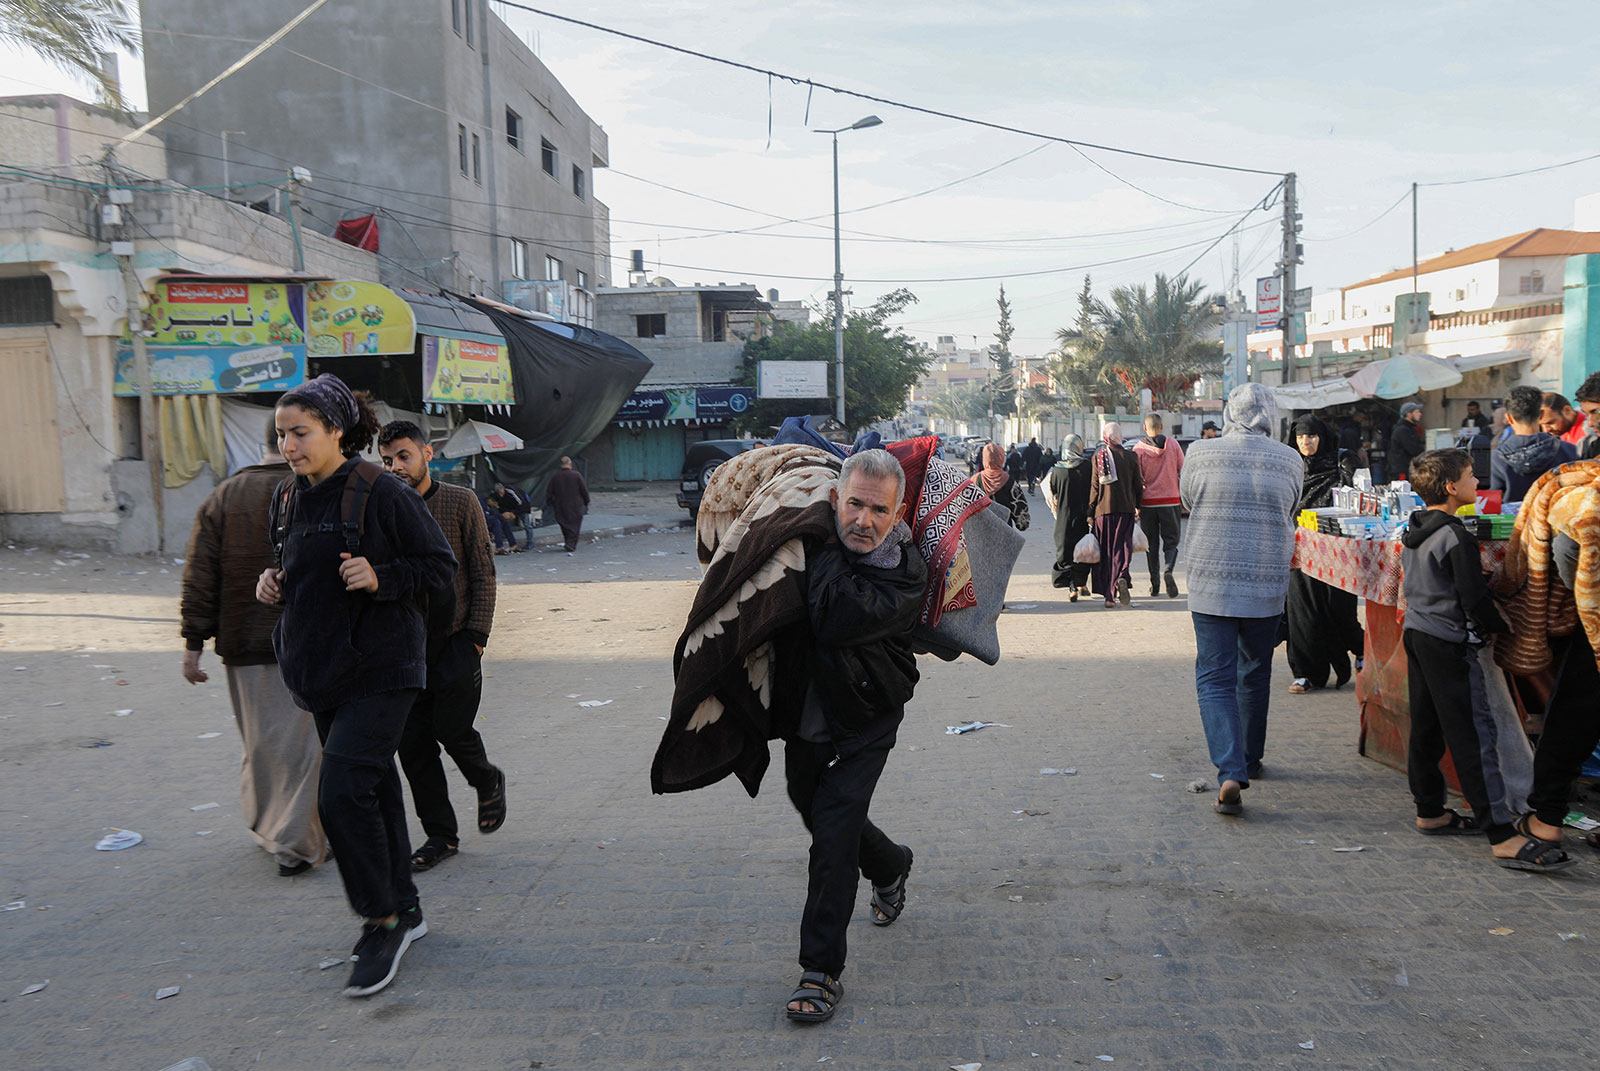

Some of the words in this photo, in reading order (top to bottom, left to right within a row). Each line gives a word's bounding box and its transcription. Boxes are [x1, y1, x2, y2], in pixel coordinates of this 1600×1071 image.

[219, 286, 246, 300] فلافل
[160, 306, 254, 332] ناصر
[236, 361, 283, 389] ناصر
[456, 365, 500, 389] ناصر
[638, 398, 664, 408] سوبر
[697, 397, 729, 410] صبا
